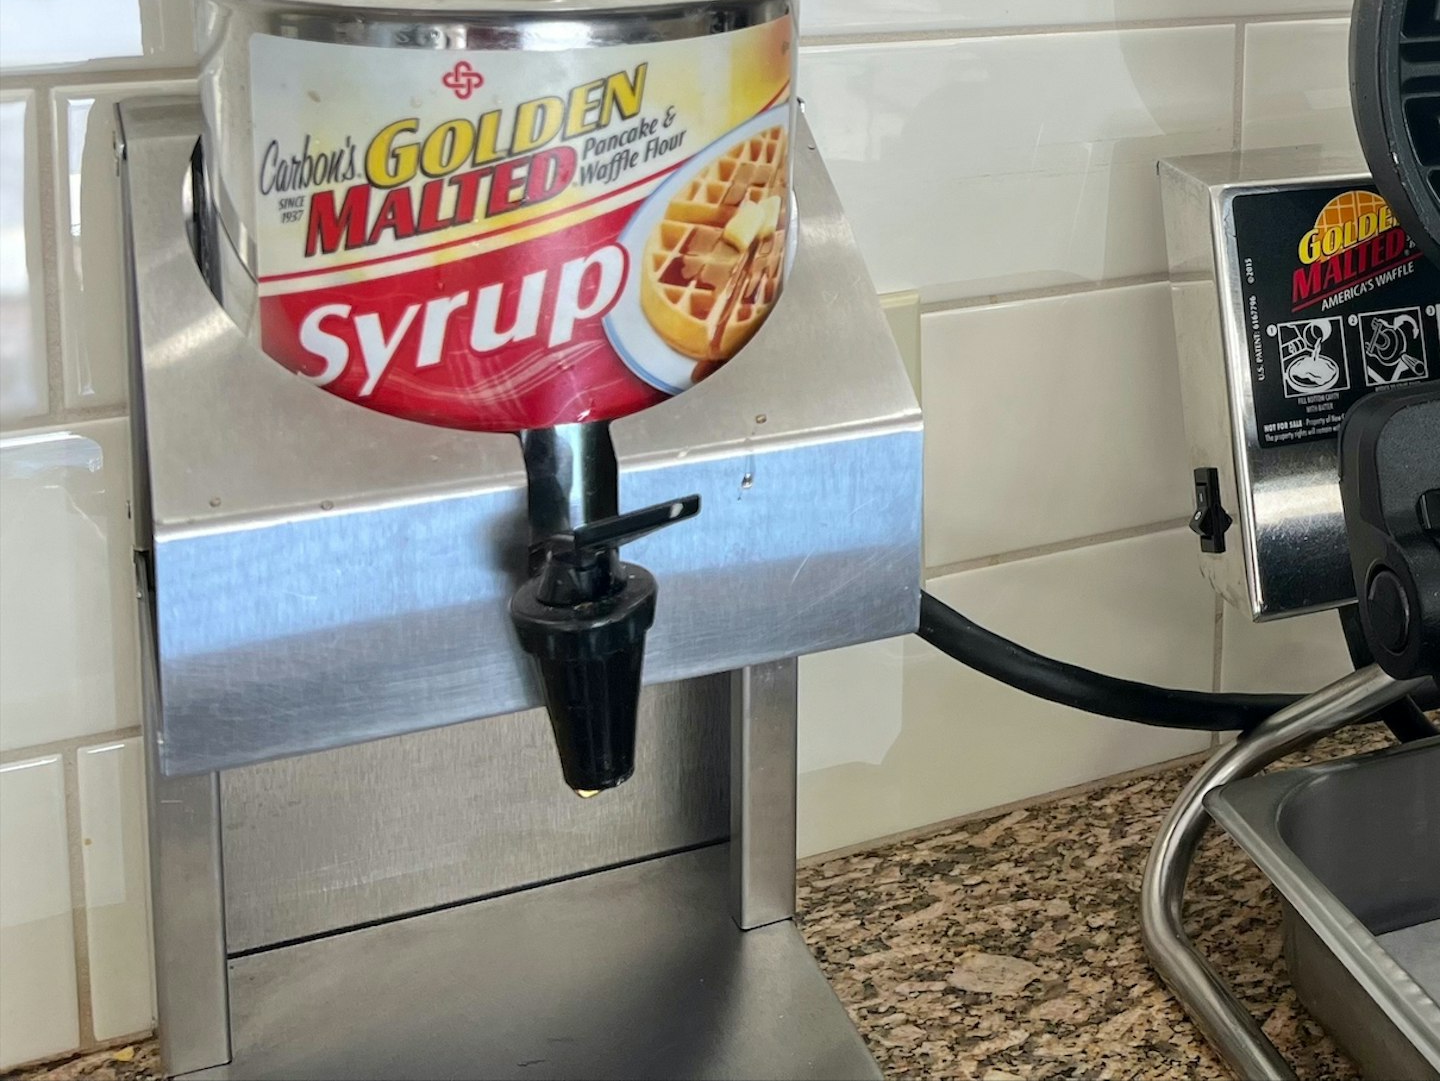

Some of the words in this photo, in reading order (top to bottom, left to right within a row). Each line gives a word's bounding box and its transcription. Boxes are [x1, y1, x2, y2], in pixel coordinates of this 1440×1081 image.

[259, 133, 357, 196] Carbon's
[364, 61, 649, 190] GOLDEN
[582, 117, 659, 161] Pancake
[663, 104, 677, 129] &
[579, 149, 639, 186] Waffle
[643, 129, 688, 163] Flour
[278, 195, 305, 211] SINCE
[281, 209, 305, 224] 1937
[304, 145, 579, 258] MALTED
[1298, 205, 1399, 265] GOLDE
[1292, 226, 1407, 302] MALTED
[1321, 277, 1375, 312] AMERICA'S
[1375, 260, 1416, 288] WAFFLE
[298, 243, 629, 397] Syrup
[1252, 331, 1264, 364] PATENT:
[1257, 364, 1266, 381] U.S.
[1263, 423, 1276, 433] NOT
[1276, 421, 1289, 431] FOR
[1289, 419, 1303, 429] SALE
